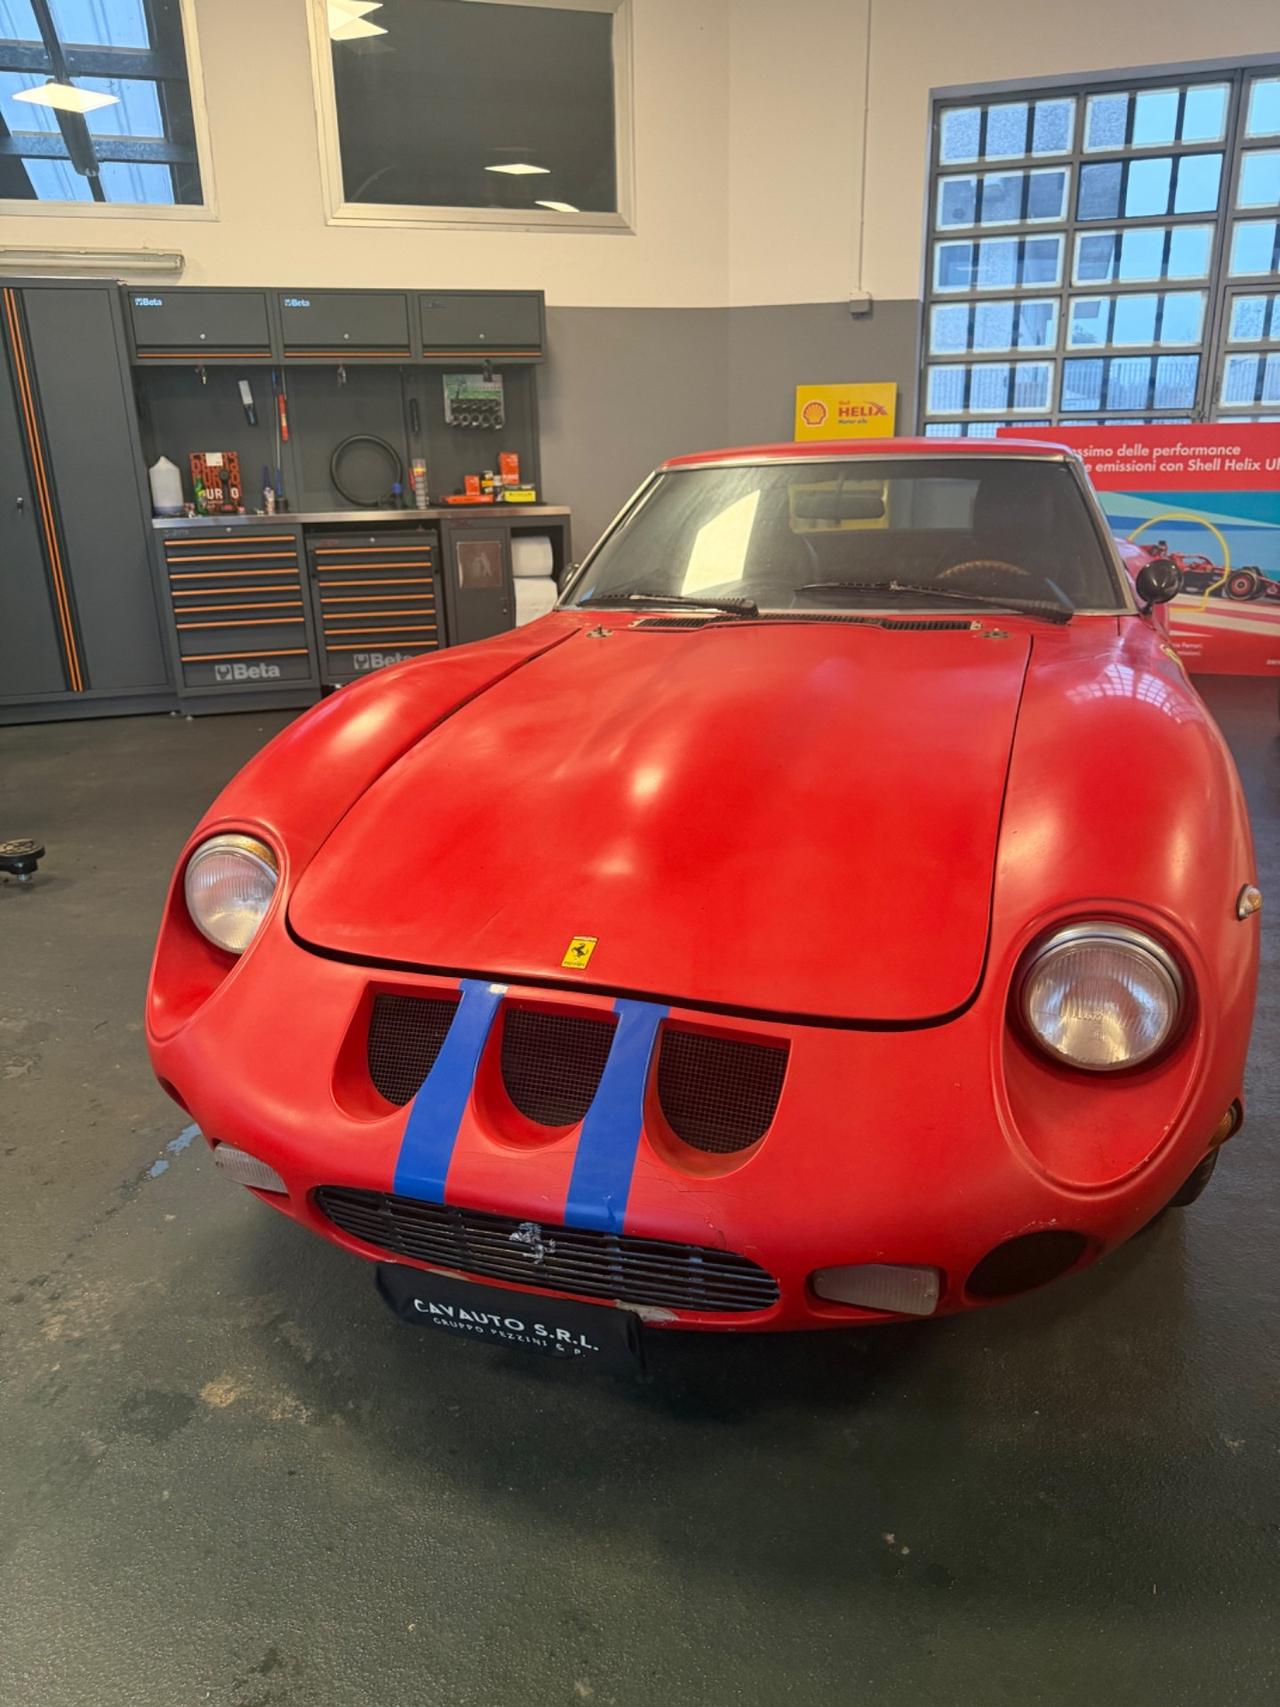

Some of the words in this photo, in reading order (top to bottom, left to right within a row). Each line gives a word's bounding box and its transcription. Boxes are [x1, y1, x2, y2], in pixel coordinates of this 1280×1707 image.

[290, 298, 310, 307] Beta
[838, 406, 888, 417] HELIX
[1116, 443, 1150, 457] delle
[1152, 442, 1241, 459] performance
[1095, 460, 1157, 472] emissioni
[1159, 462, 1184, 472] con
[1187, 458, 1221, 471] Shell
[1224, 457, 1262, 471] Helix
[233, 662, 281, 680] Beta
[414, 1298, 525, 1331] CAVAUTO
[533, 1323, 599, 1351] S.R.L.
[433, 1317, 485, 1334] GRUPPO
[490, 1328, 548, 1347] PEZZINI
